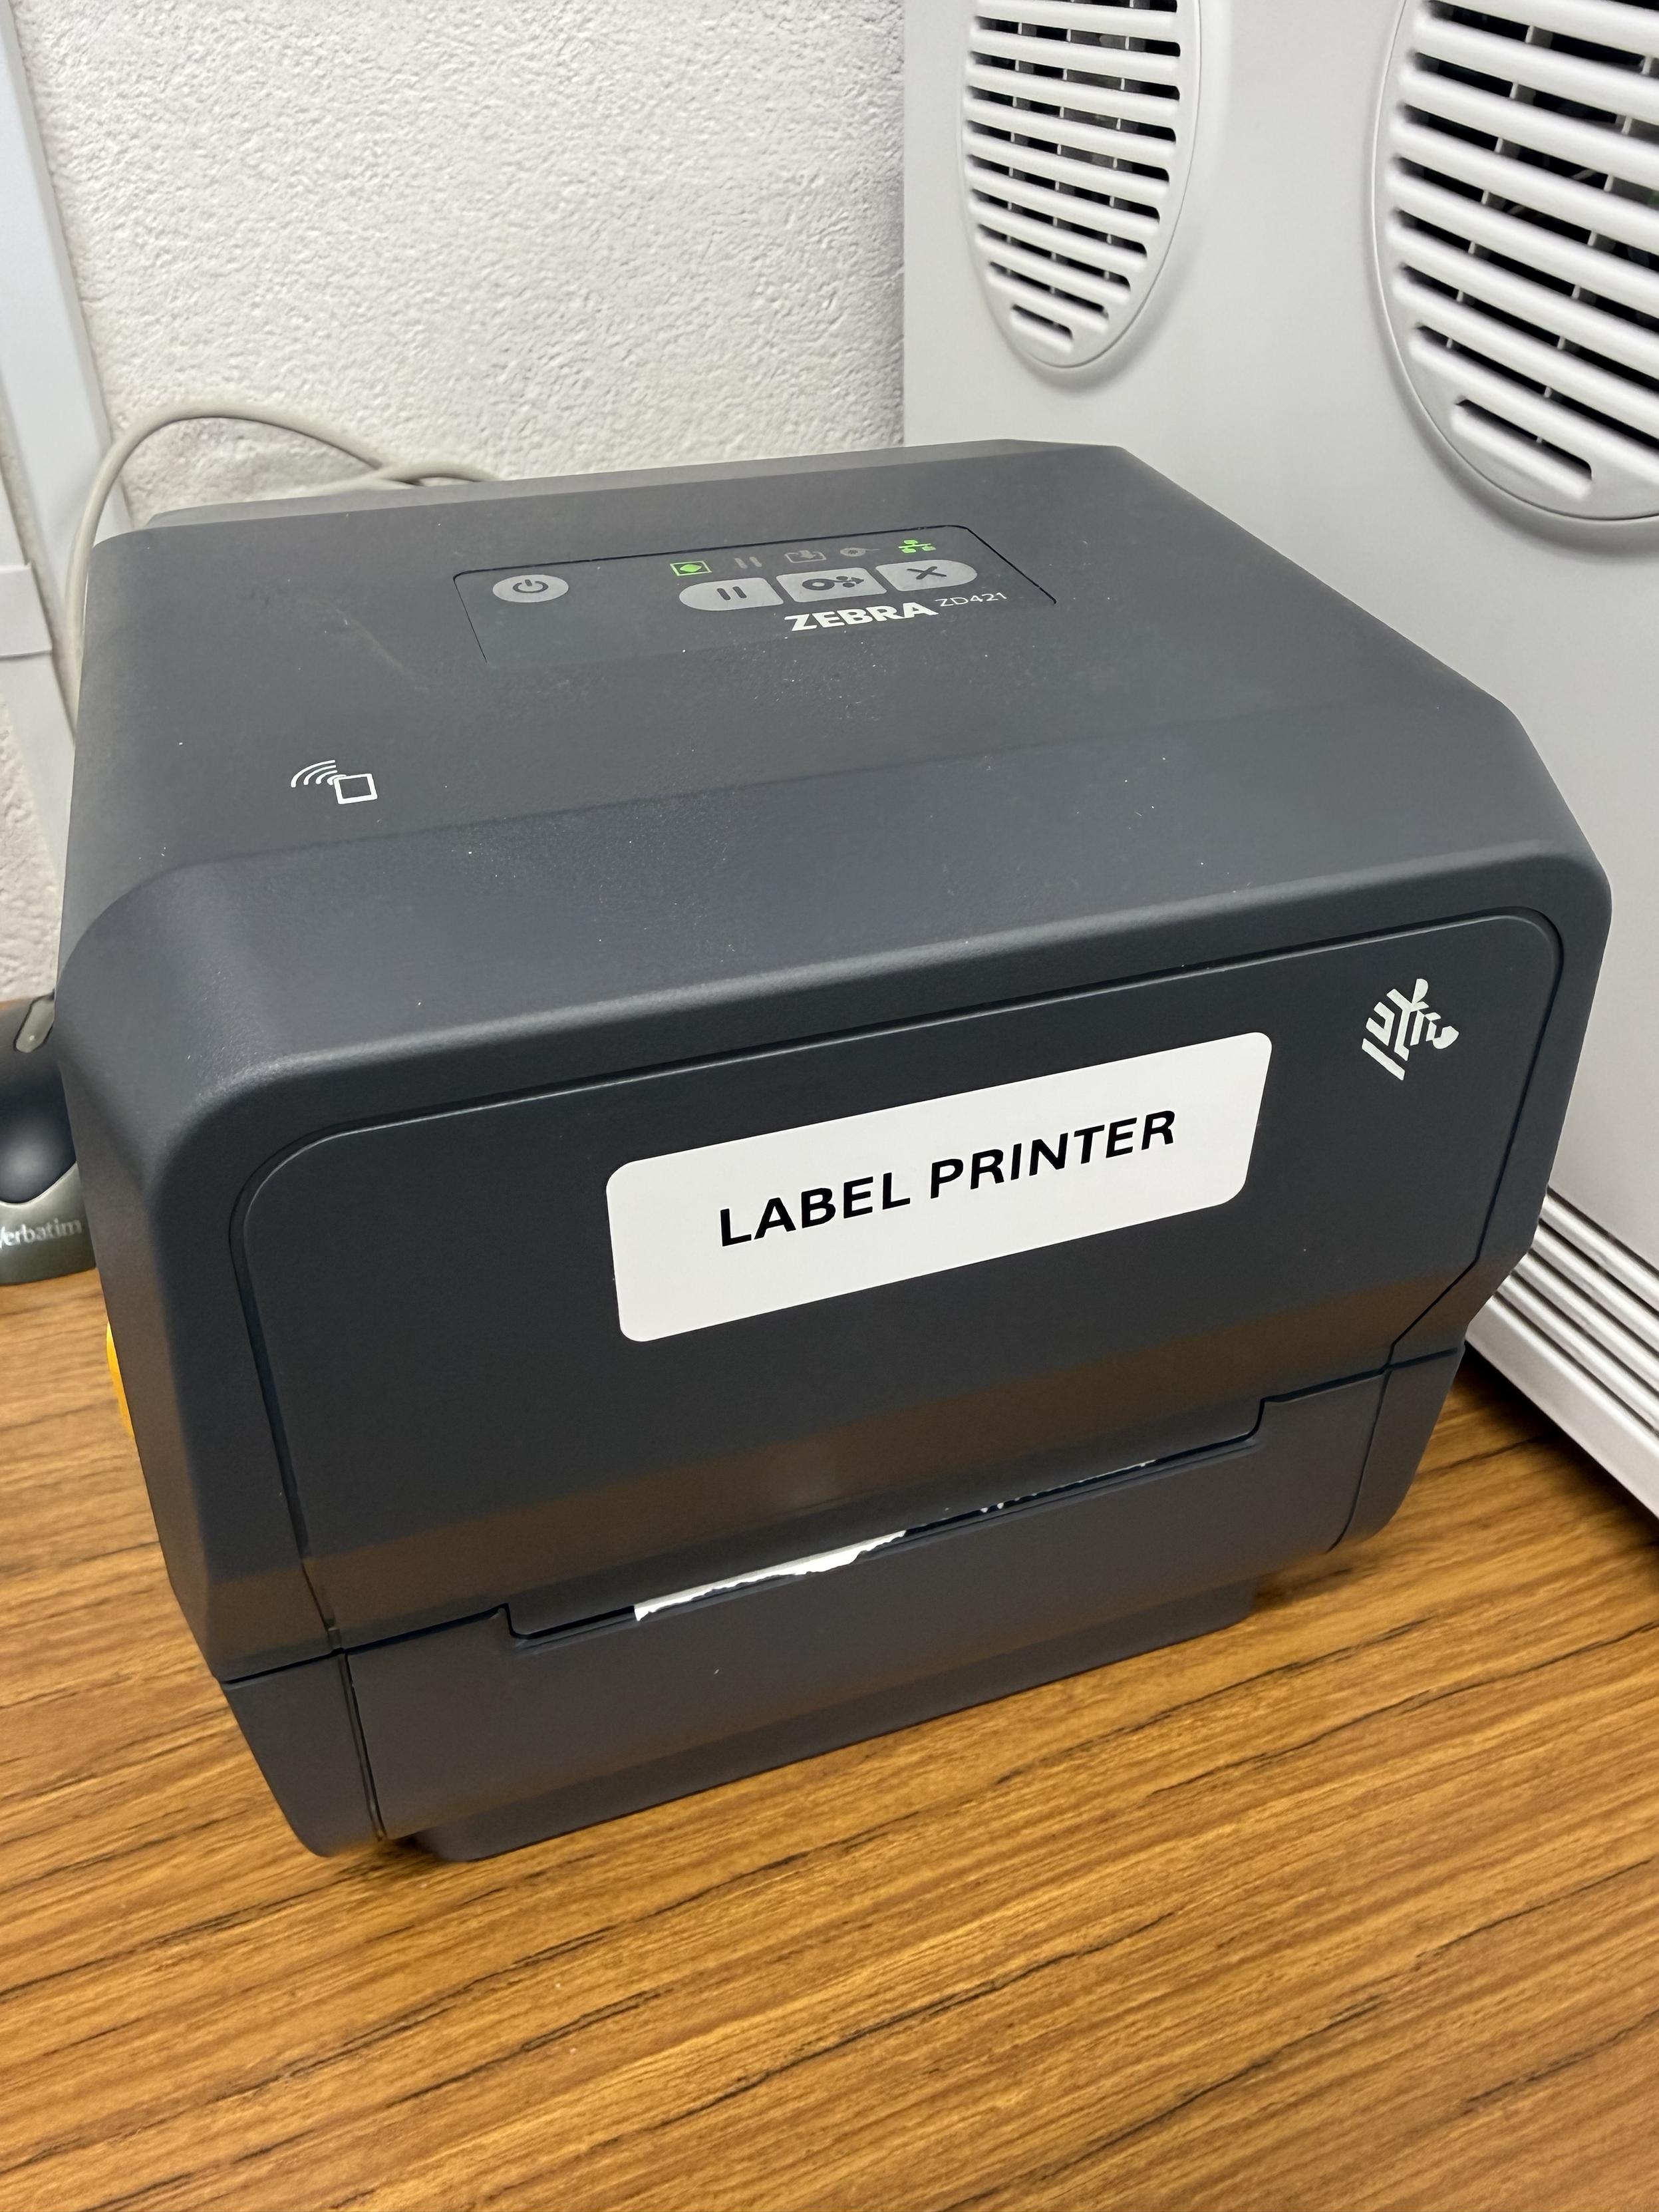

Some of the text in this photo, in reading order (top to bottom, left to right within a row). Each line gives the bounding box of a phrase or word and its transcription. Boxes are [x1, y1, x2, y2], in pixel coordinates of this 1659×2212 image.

[784, 592, 1007, 631] ZEBRA ZD421
[720, 1110, 1175, 1247] LABEL PRINTER
